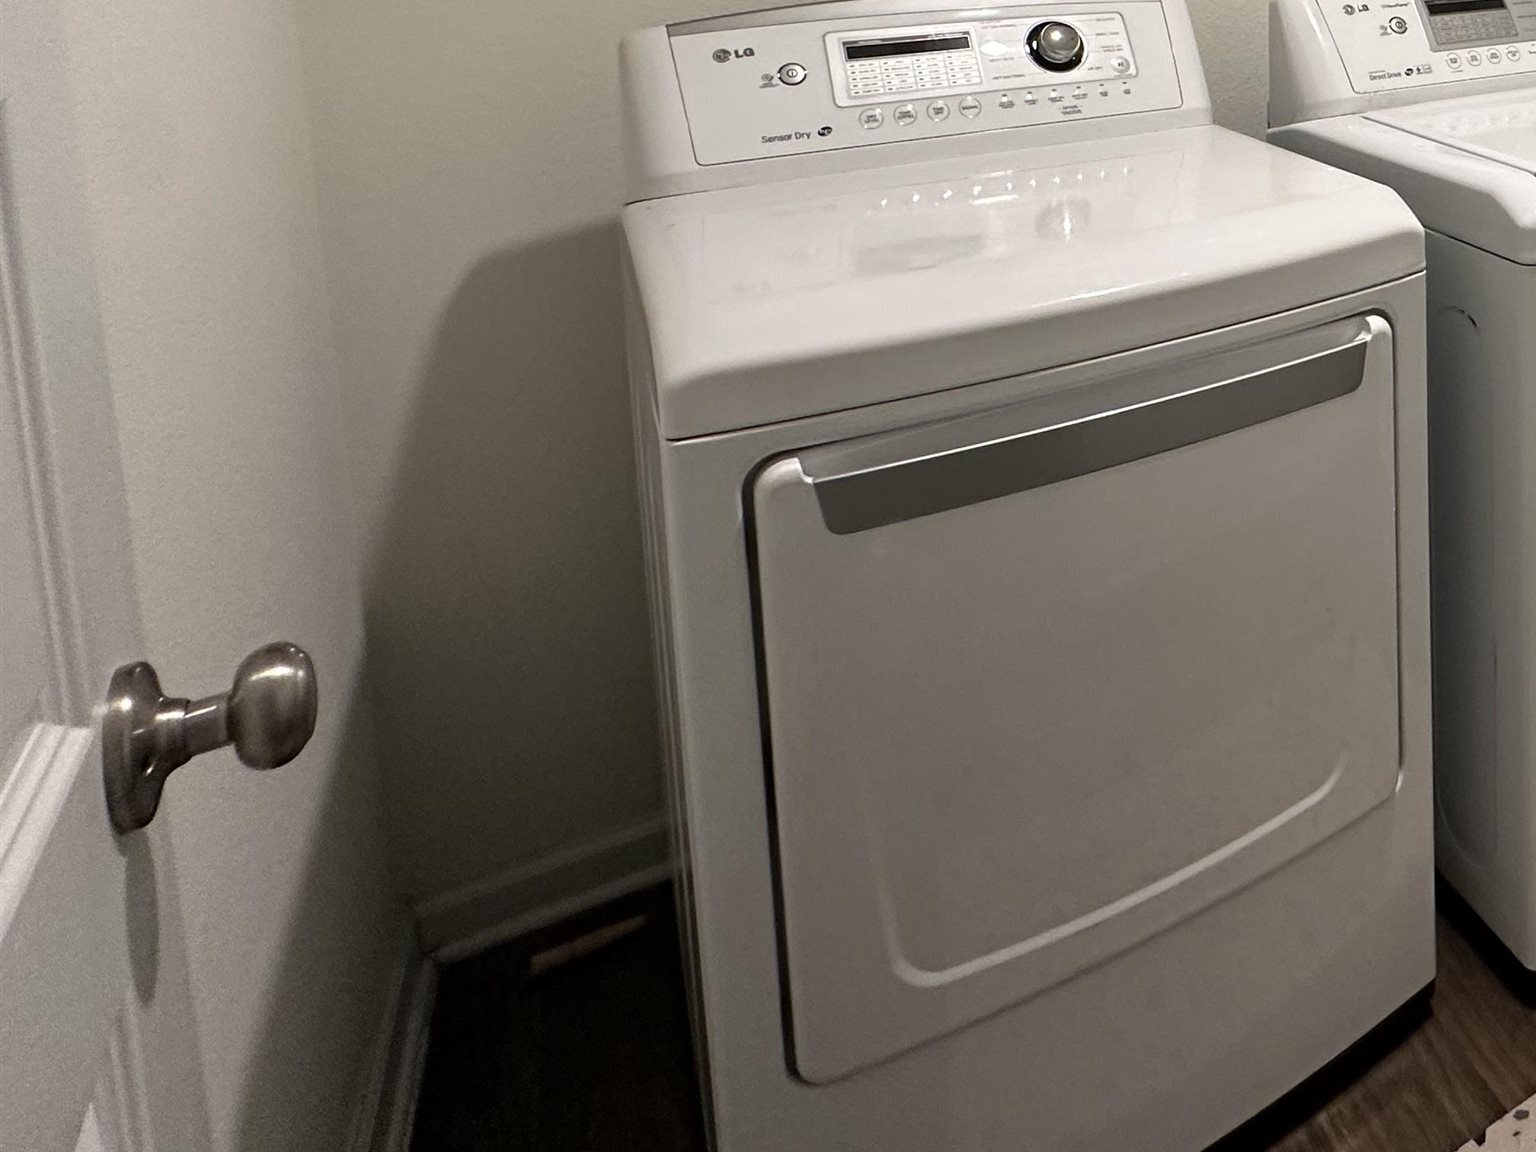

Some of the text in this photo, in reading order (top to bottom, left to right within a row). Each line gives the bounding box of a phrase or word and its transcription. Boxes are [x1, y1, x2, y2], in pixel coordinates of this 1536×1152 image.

[734, 48, 755, 59] LG
[761, 131, 812, 144] Sensor Dry
